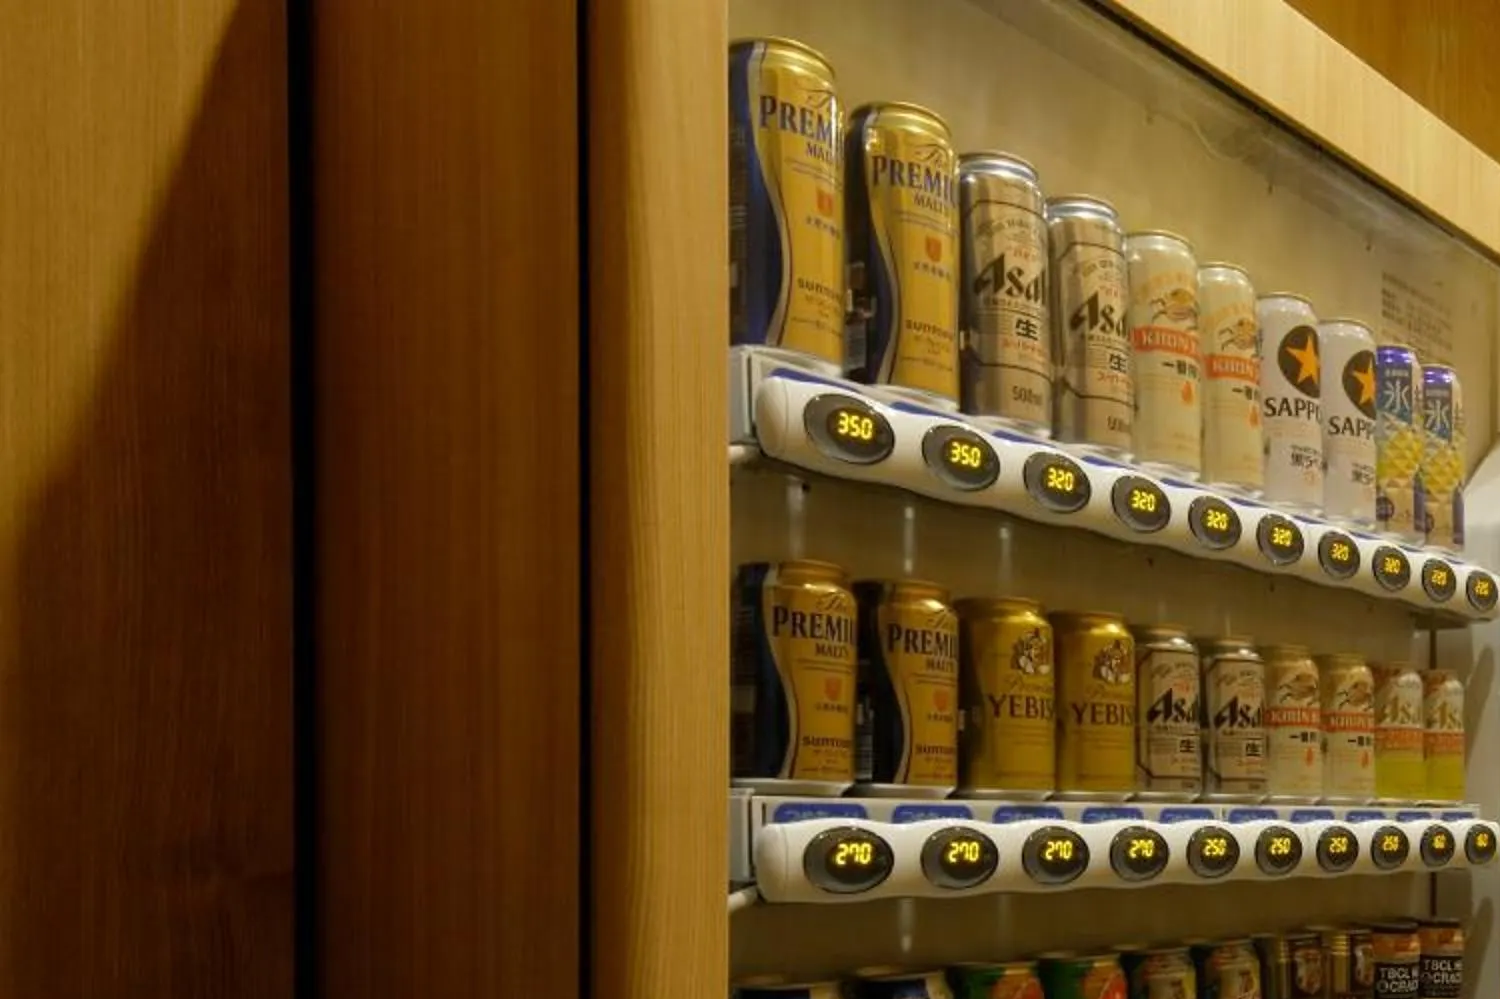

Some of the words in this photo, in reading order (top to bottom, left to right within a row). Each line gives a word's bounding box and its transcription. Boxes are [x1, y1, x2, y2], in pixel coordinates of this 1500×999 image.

[837, 411, 873, 440] 350
[1327, 416, 1373, 441] SAPP
[950, 440, 982, 468] 350
[1047, 466, 1075, 492] 320
[1131, 489, 1156, 512] 320
[836, 843, 872, 865] 270
[948, 841, 979, 863] 270
[1046, 840, 1072, 860] 270
[1204, 839, 1226, 856] 250
